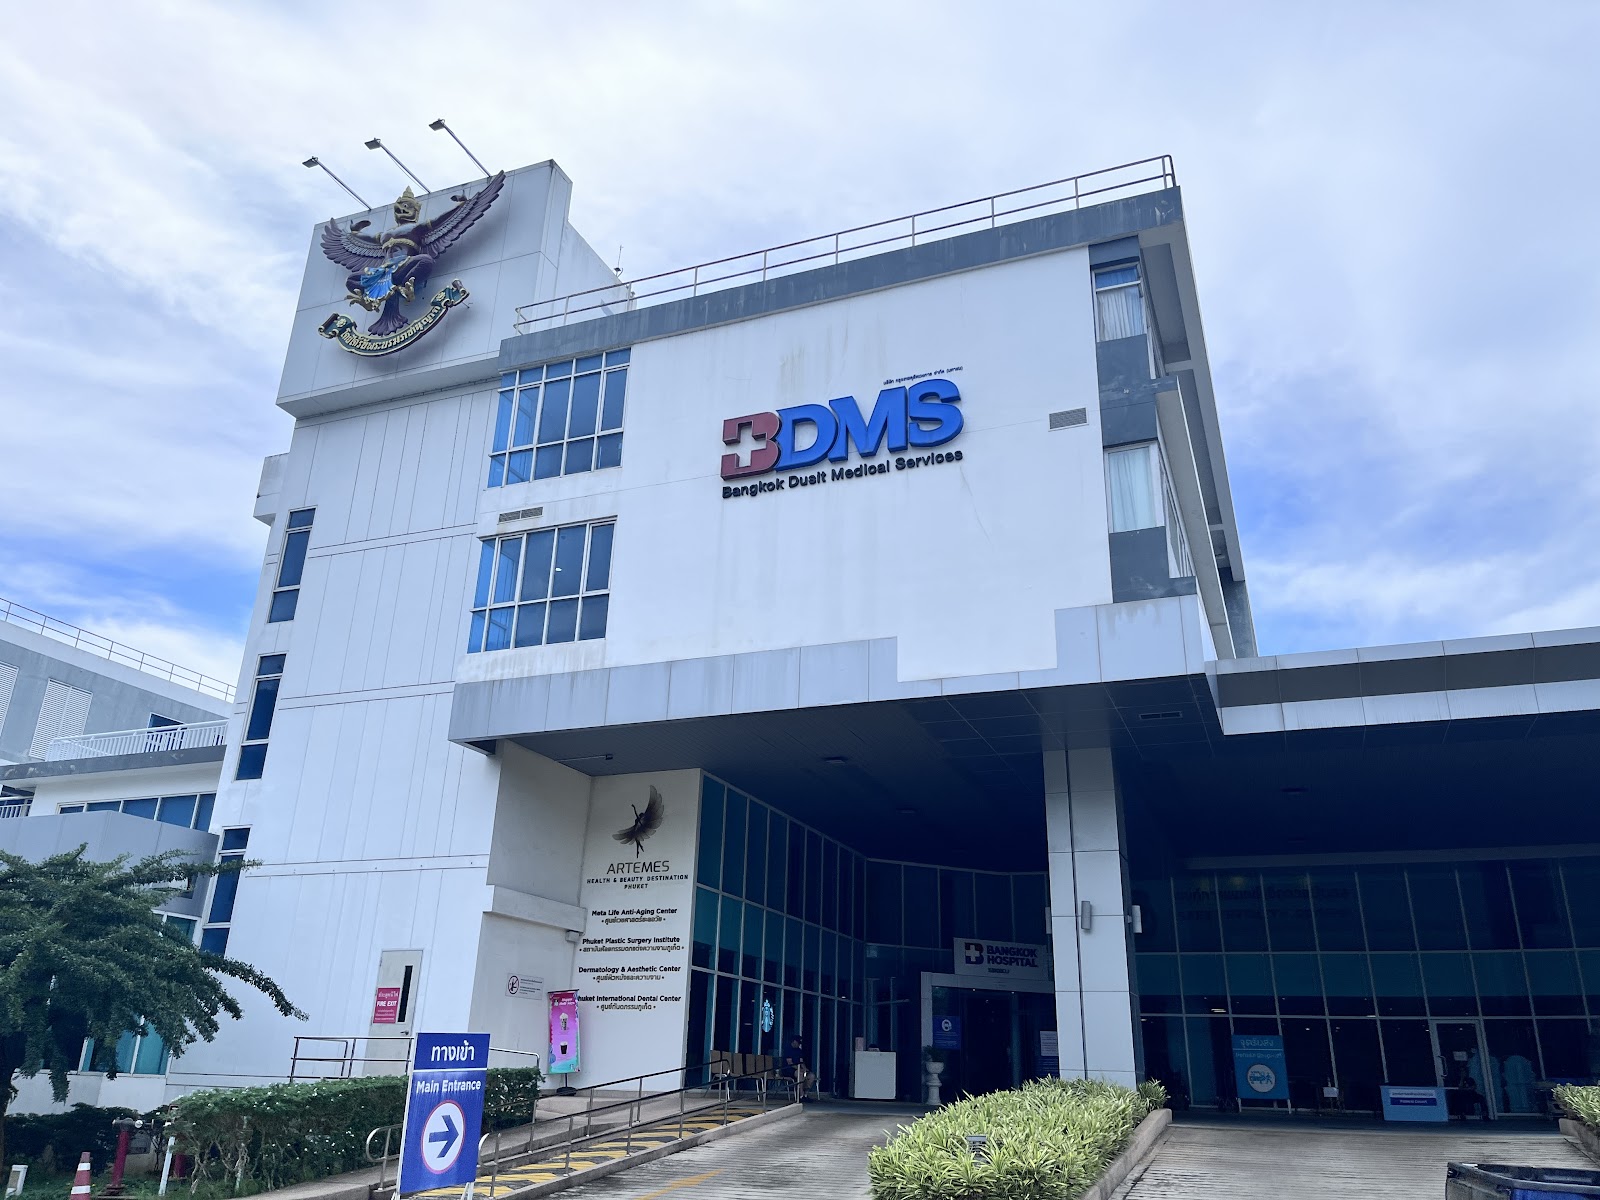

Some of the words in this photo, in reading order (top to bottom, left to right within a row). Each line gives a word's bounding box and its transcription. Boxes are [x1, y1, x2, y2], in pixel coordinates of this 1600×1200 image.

[720, 378, 965, 481] BDMS
[722, 477, 785, 499] Bangkok
[788, 468, 827, 489] Dusit
[831, 459, 890, 482] Medical
[895, 449, 963, 471] Services
[606, 860, 670, 875] ARTEMES
[646, 874, 689, 882] DESTINATION
[621, 908, 655, 917] Anti-Aging
[627, 937, 652, 945] Surgery
[986, 945, 1038, 958] BANGKOK
[986, 955, 1039, 968] HOSPITAL
[578, 966, 620, 974] Dermatology
[430, 1039, 475, 1062] ทางเข้า
[416, 1079, 440, 1094] Main
[441, 1079, 482, 1094] Entrance
